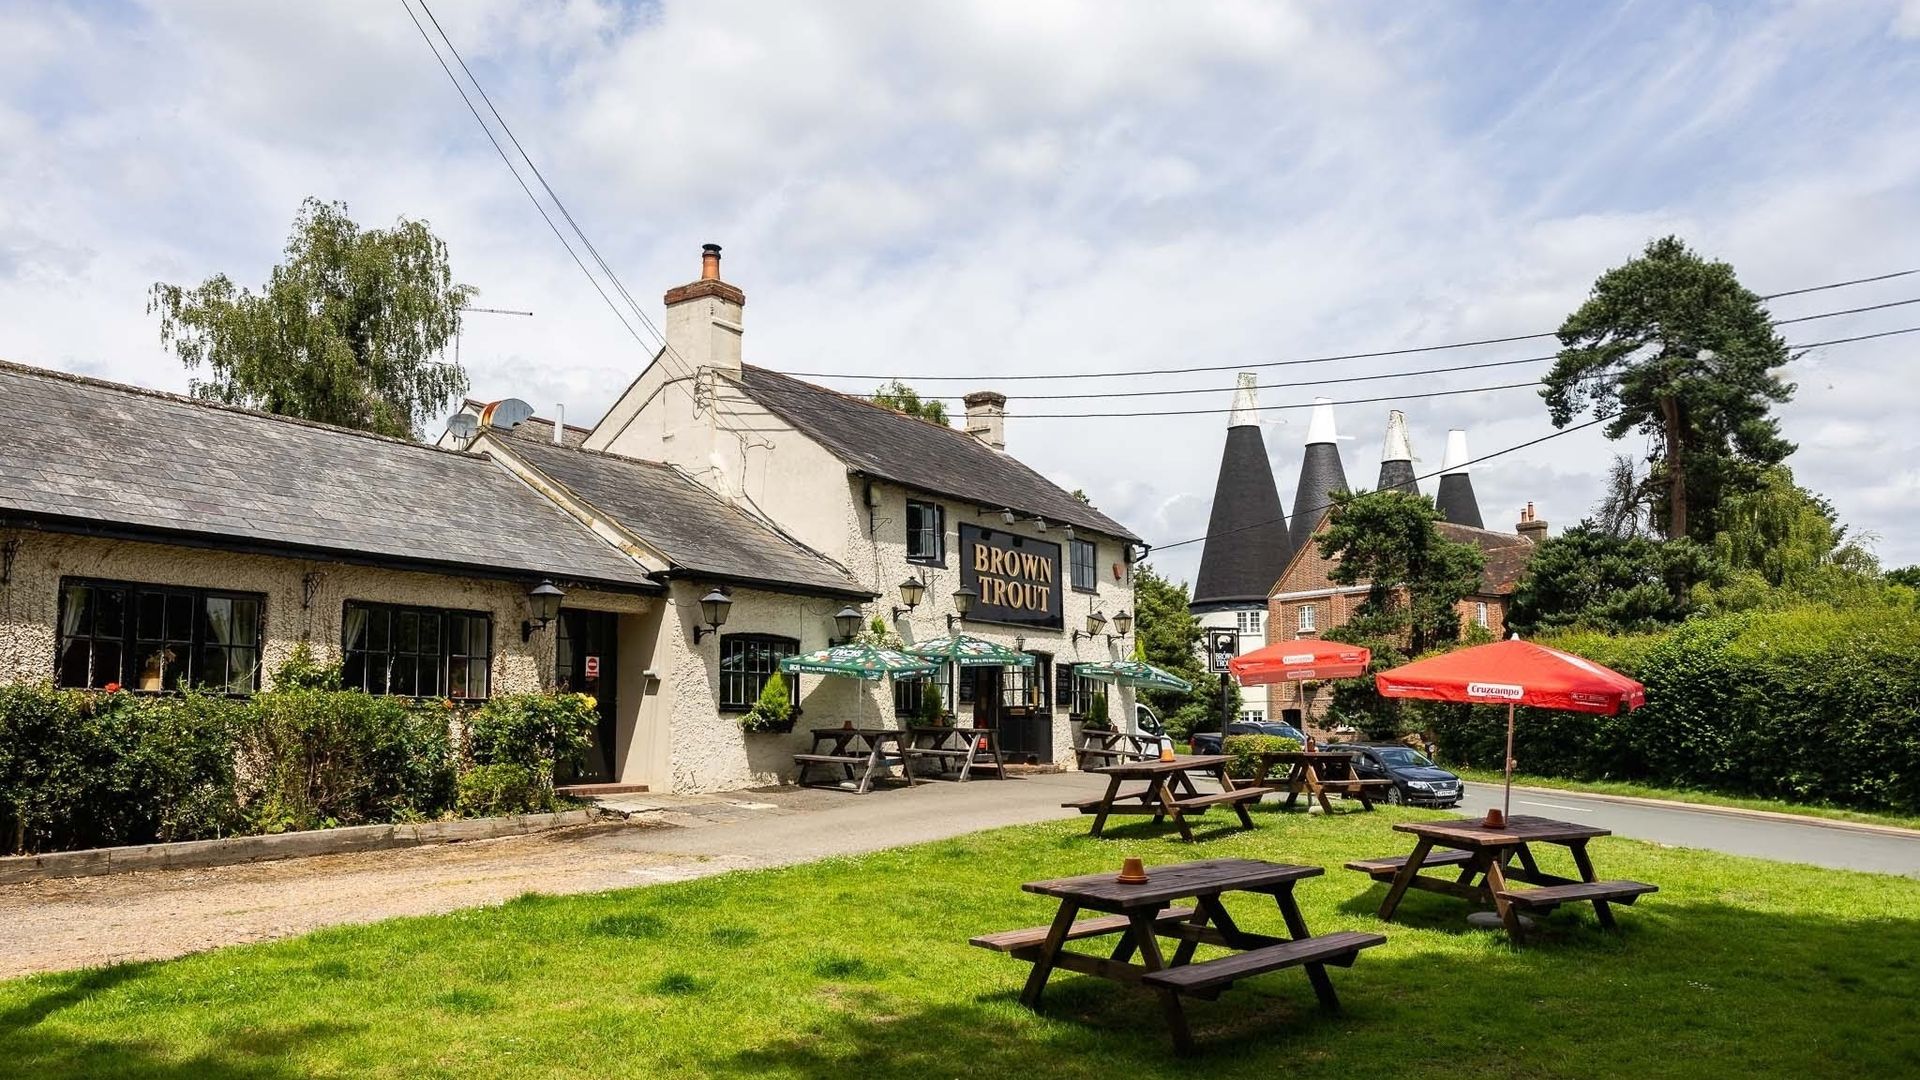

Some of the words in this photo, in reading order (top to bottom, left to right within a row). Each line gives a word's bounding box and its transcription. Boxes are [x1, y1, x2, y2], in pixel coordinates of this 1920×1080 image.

[974, 543, 1052, 583] BROWN
[978, 575, 1050, 612] TROUT
[1471, 684, 1520, 697] Cruzcampo
